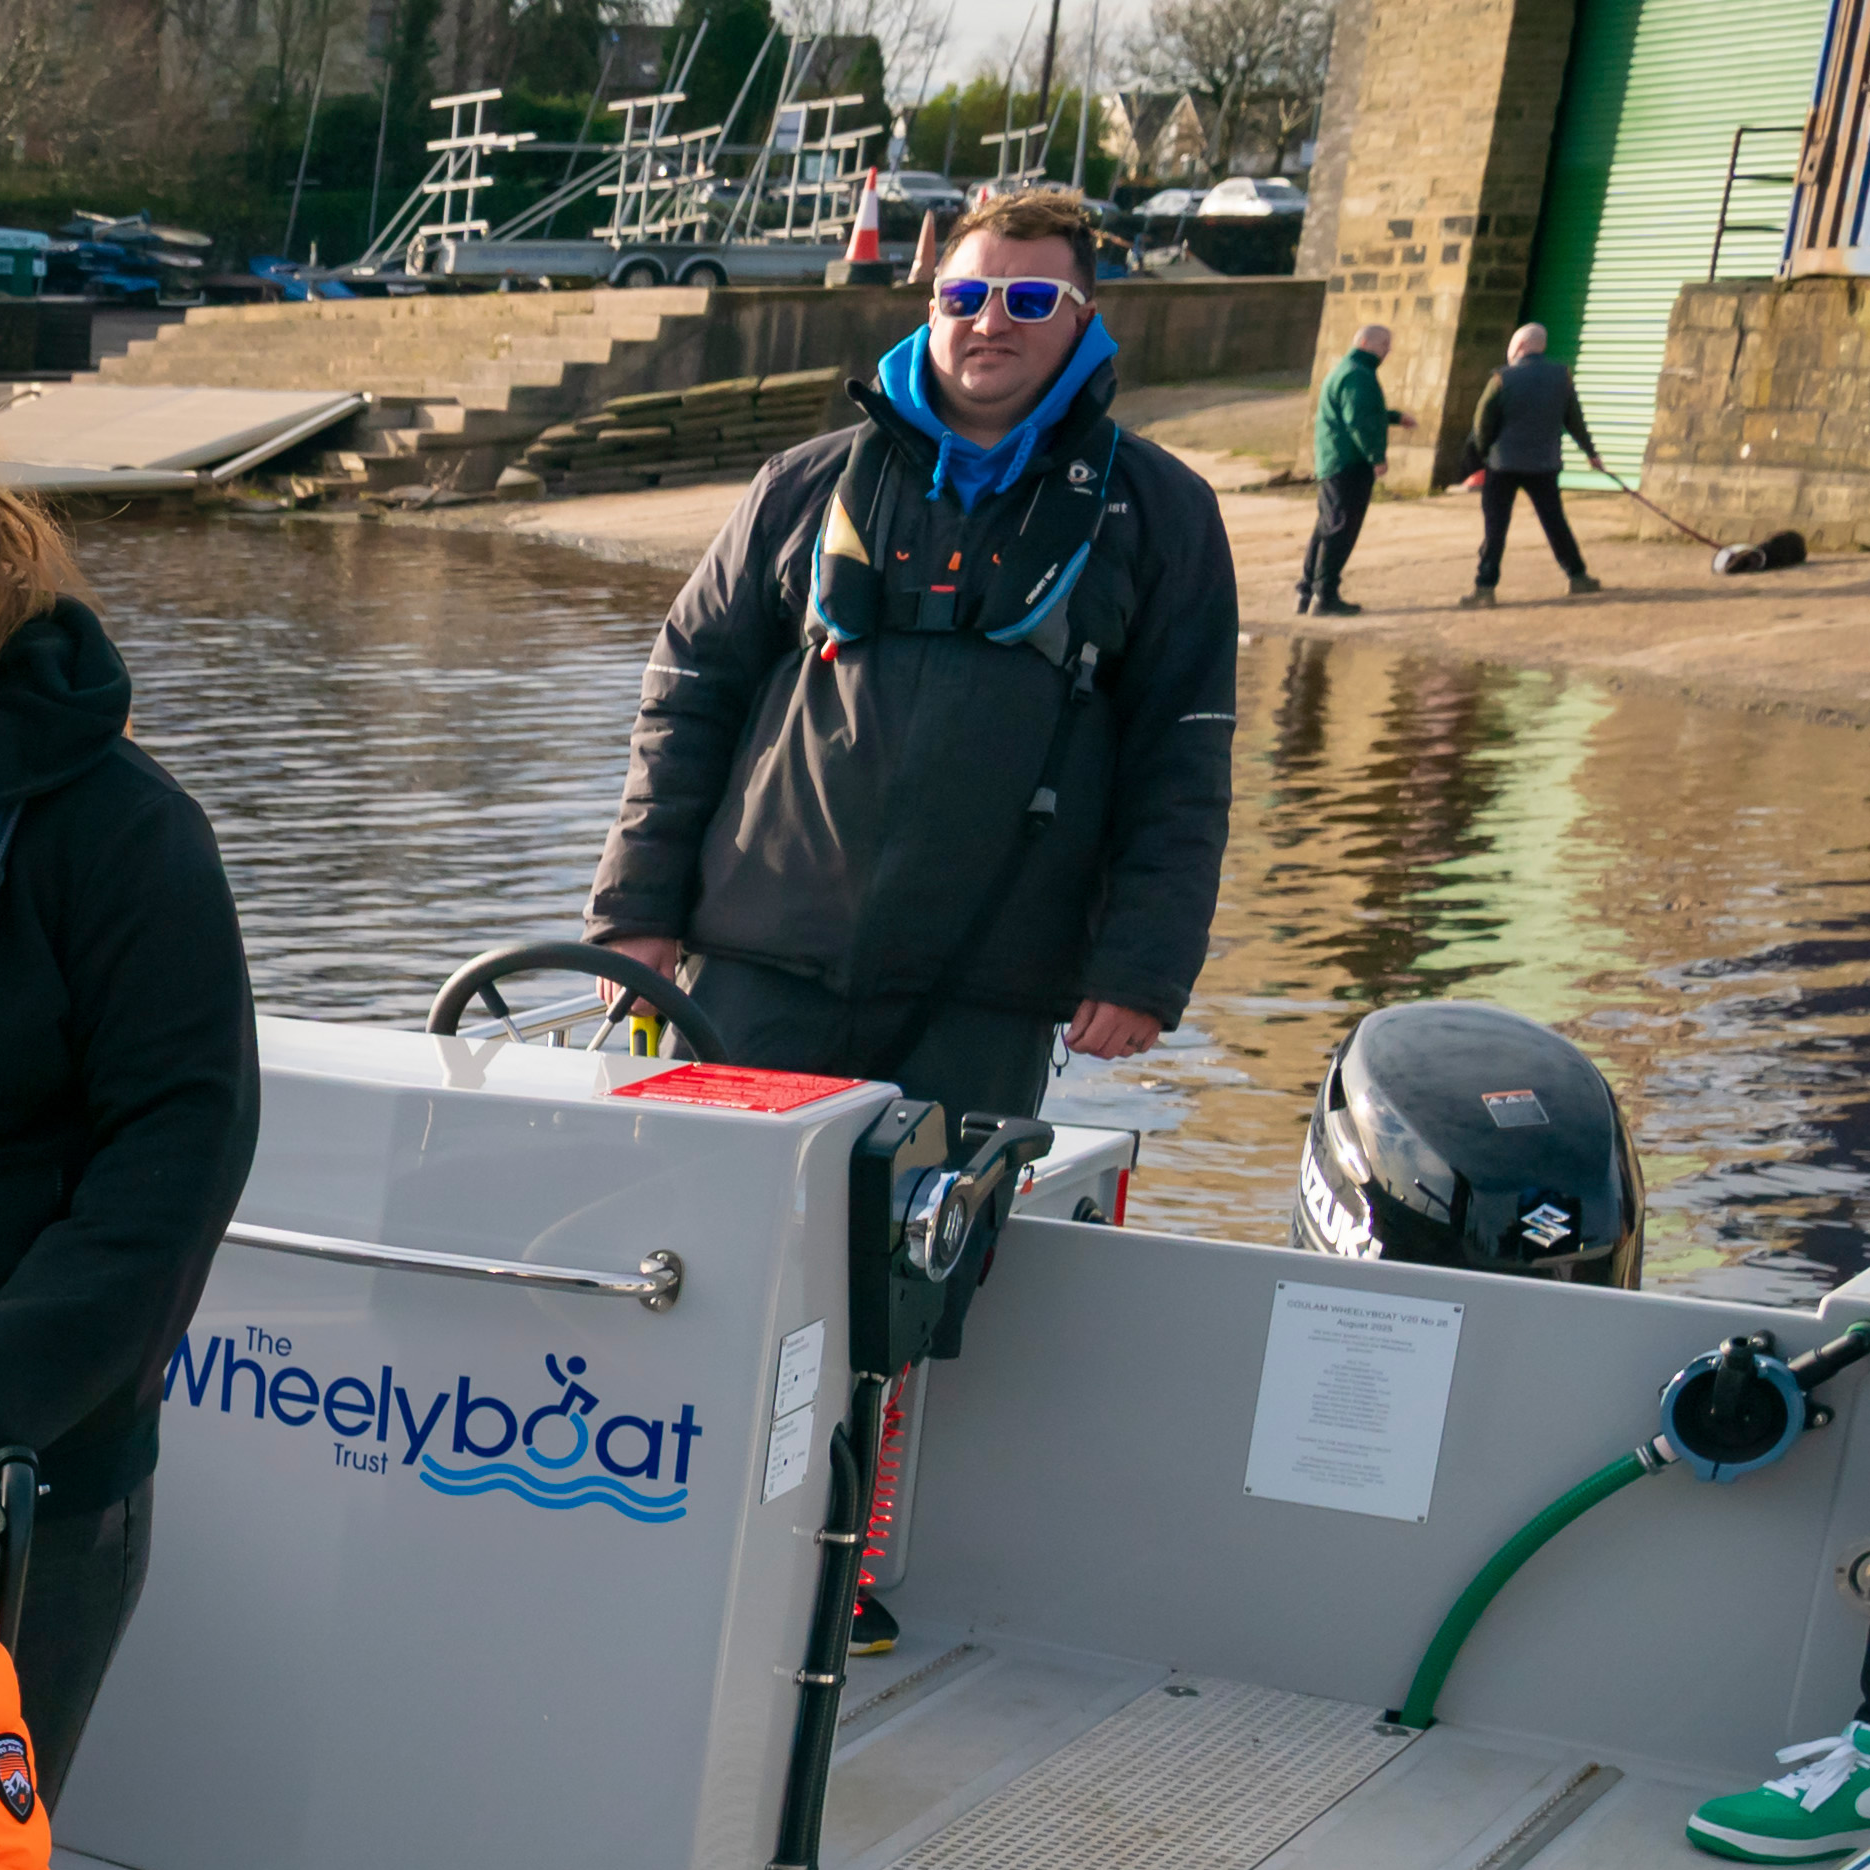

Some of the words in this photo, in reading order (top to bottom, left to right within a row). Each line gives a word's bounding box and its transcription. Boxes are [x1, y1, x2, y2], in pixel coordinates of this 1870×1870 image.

[1330, 1305, 1400, 1322] WHEELYBOAT
[245, 1326, 292, 1357] The
[333, 1442, 389, 1475] Trust
